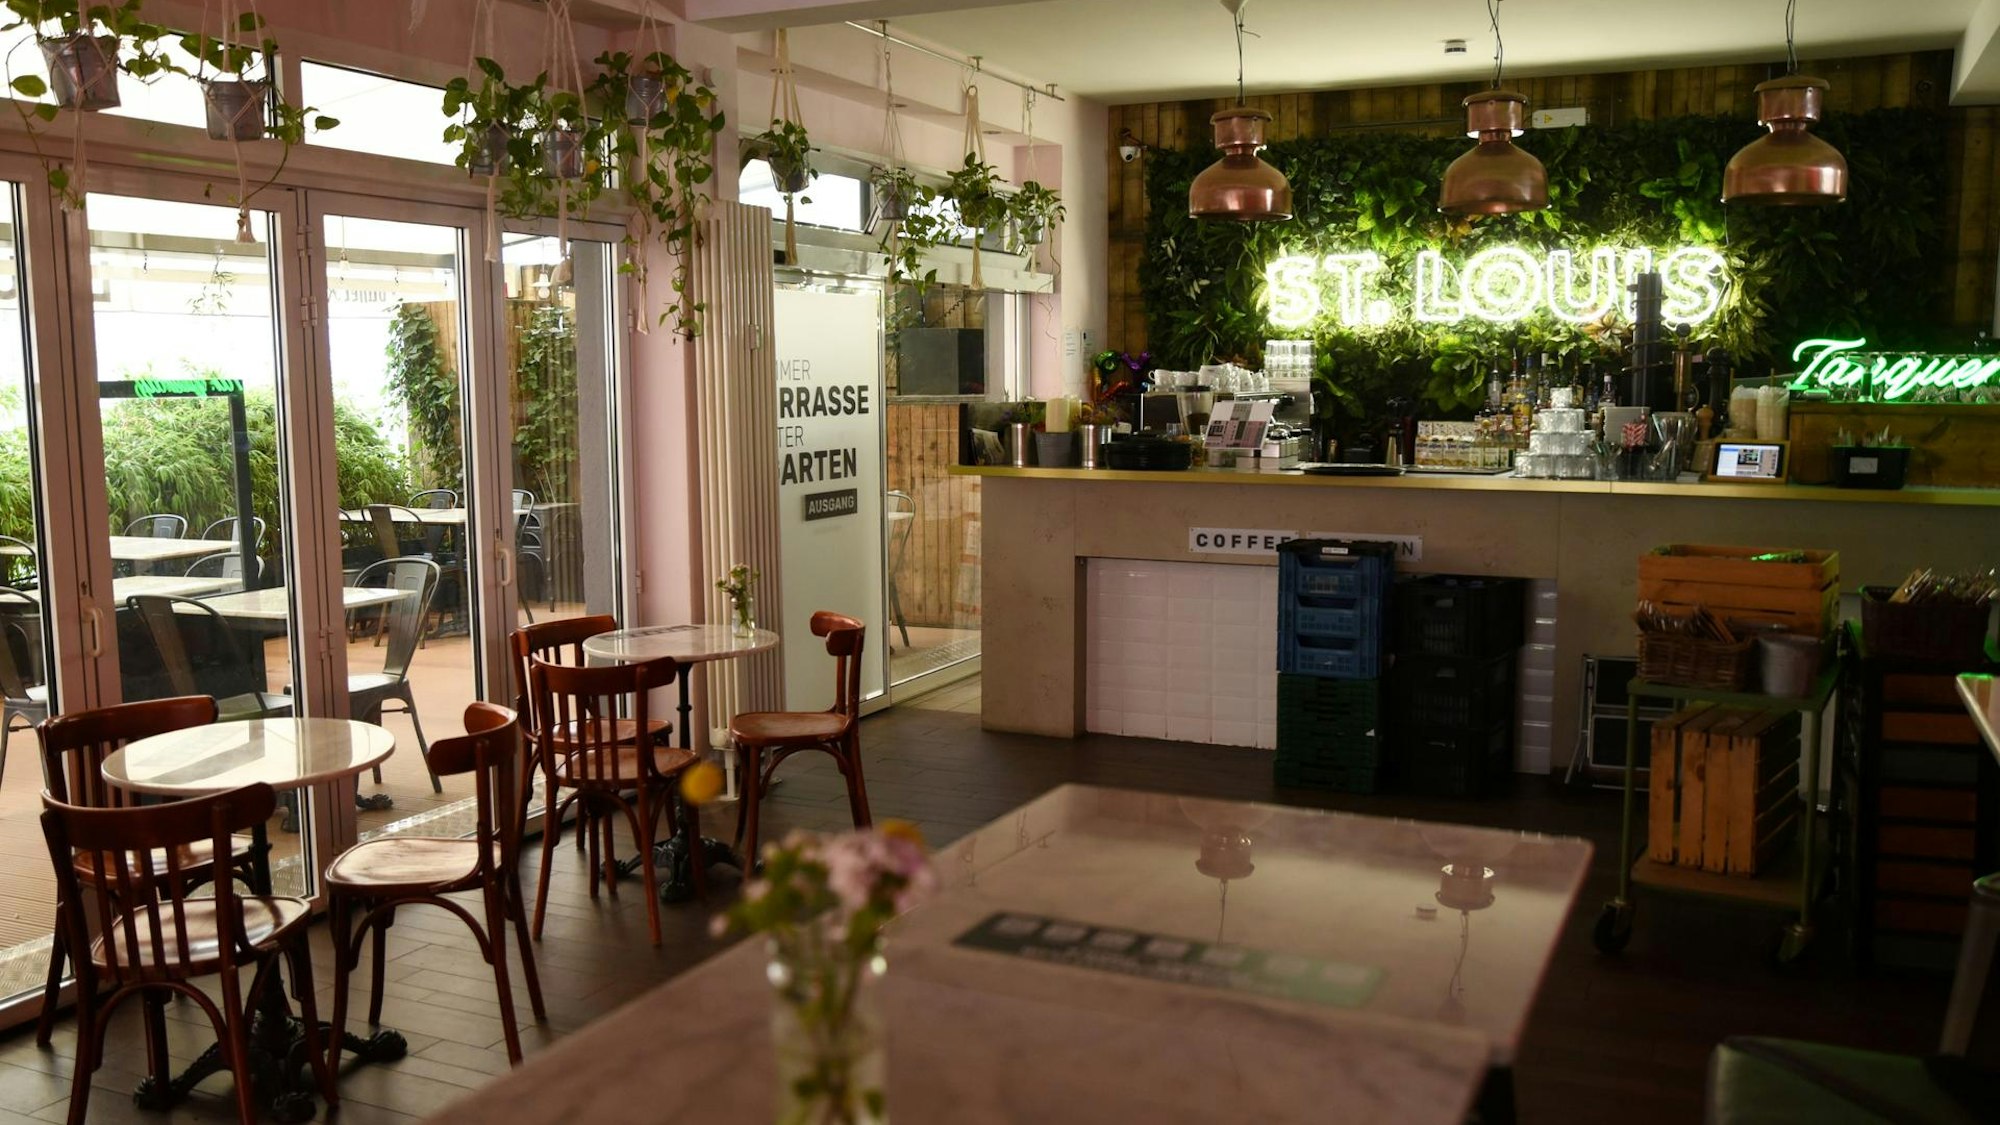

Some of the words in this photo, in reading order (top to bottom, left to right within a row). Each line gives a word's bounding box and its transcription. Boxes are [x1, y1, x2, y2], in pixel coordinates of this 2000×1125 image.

[1266, 252, 1393, 327] ST.
[776, 359, 811, 381] MER
[778, 447, 857, 486] ARTEN
[808, 495, 855, 515] AUSGANG
